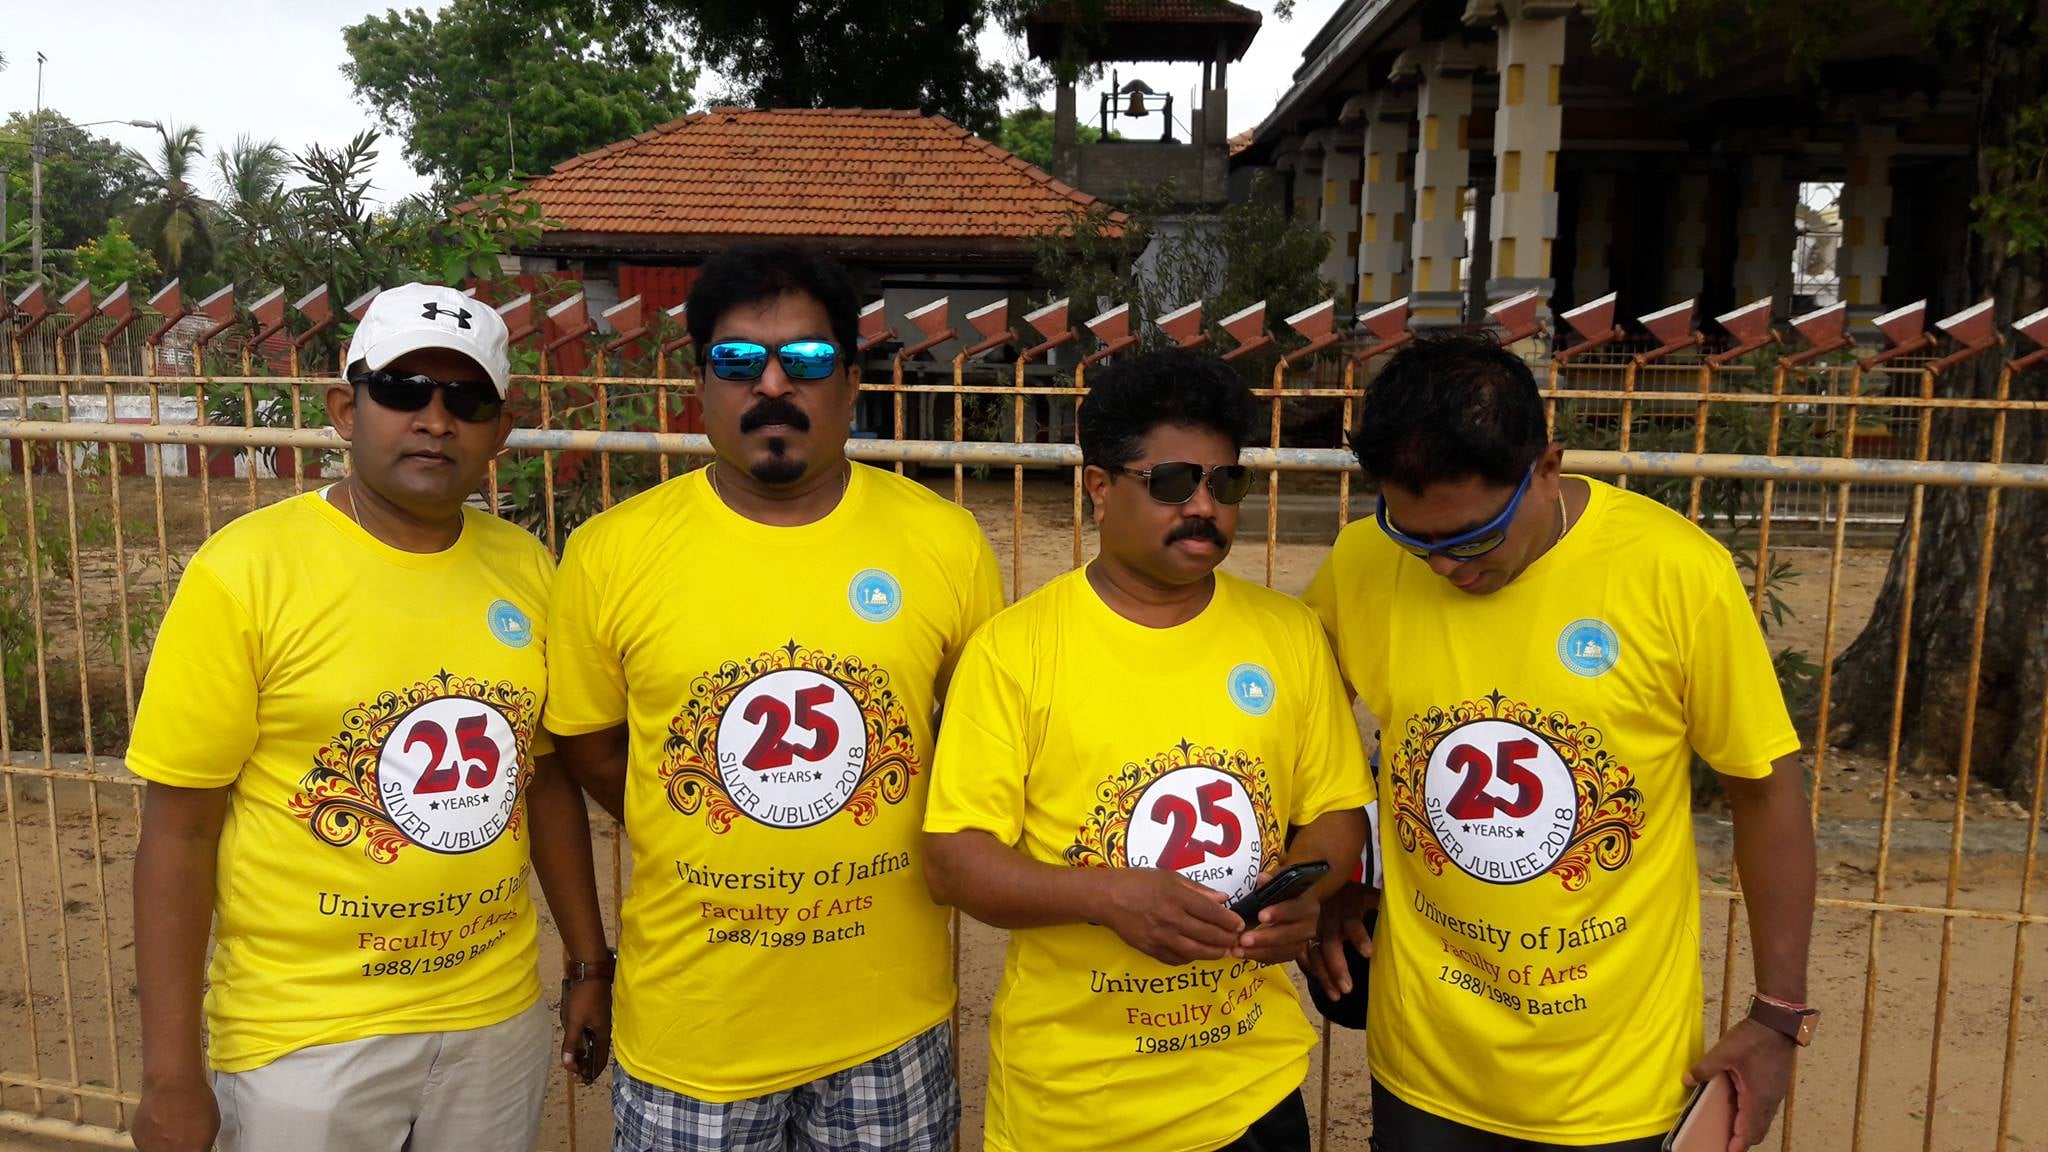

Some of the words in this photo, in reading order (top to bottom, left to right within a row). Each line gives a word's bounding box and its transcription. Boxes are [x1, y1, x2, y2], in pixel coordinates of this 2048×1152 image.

[743, 684, 839, 770] 25
[403, 713, 500, 794] 25
[720, 752, 760, 811] SILVER
[760, 793, 839, 823] JUBLIEE
[835, 746, 864, 796] 2018
[771, 771, 811, 784] YEARS
[1445, 738, 1543, 820] 25
[382, 781, 430, 839] SILVER
[431, 813, 503, 849] JUBLIEE
[500, 767, 518, 815] 2018
[441, 794, 481, 811] YEARS
[1150, 779, 1242, 871] 25
[1426, 797, 1463, 860] SILVER
[1464, 852, 1544, 880] JUBLIEE
[1540, 807, 1573, 859] 2018
[1473, 824, 1514, 838] YEARS
[676, 861, 805, 894] University
[814, 861, 844, 886] of
[848, 849, 910, 886] Jaffna
[1186, 867, 1225, 882] YEARS
[1244, 841, 1260, 890] 2018
[318, 890, 471, 920] University
[479, 878, 505, 904] of
[505, 861, 531, 902] Jaff
[700, 901, 790, 926] Faculty
[797, 900, 823, 922] of
[826, 896, 873, 916] Arts
[358, 929, 452, 952] Faculty
[459, 915, 482, 938] of
[706, 927, 806, 948] 1988/1989
[811, 921, 865, 944] Batch
[1414, 889, 1511, 952] University
[1520, 926, 1550, 950] of
[1556, 915, 1628, 954] Jaffna
[362, 953, 465, 977] 1988/1989
[1089, 966, 1224, 994] University
[1507, 965, 1531, 986] of
[1538, 962, 1589, 987] Arts
[1126, 1001, 1211, 1028] Faculty
[1221, 989, 1236, 1016] of
[1439, 966, 1521, 1011] 1988/1989
[1526, 994, 1588, 1016] Batch
[1135, 1026, 1231, 1055] 1988/1989
[1236, 1002, 1263, 1036] Batch
